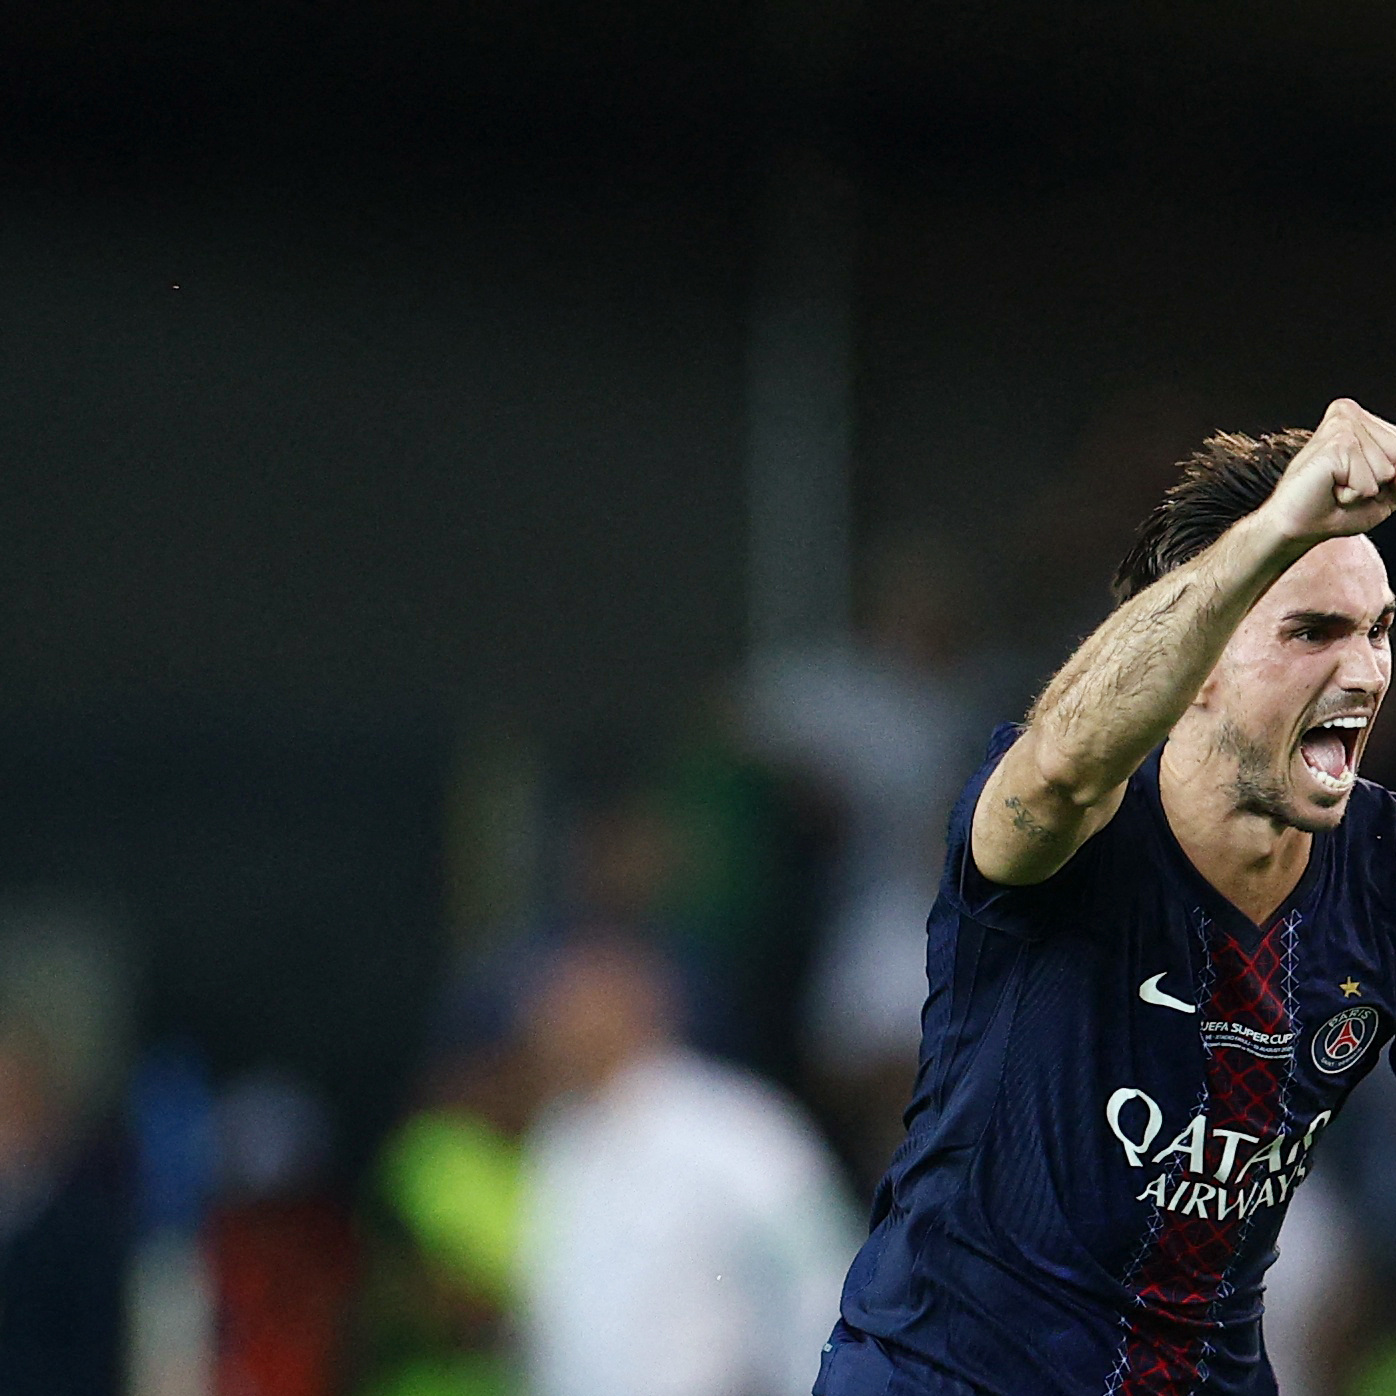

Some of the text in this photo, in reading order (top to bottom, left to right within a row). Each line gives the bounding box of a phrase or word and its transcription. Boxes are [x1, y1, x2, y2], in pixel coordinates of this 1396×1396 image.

[1328, 1009, 1372, 1027] PARIS
[1200, 1021, 1295, 1045] UEFA SUPER CUP
